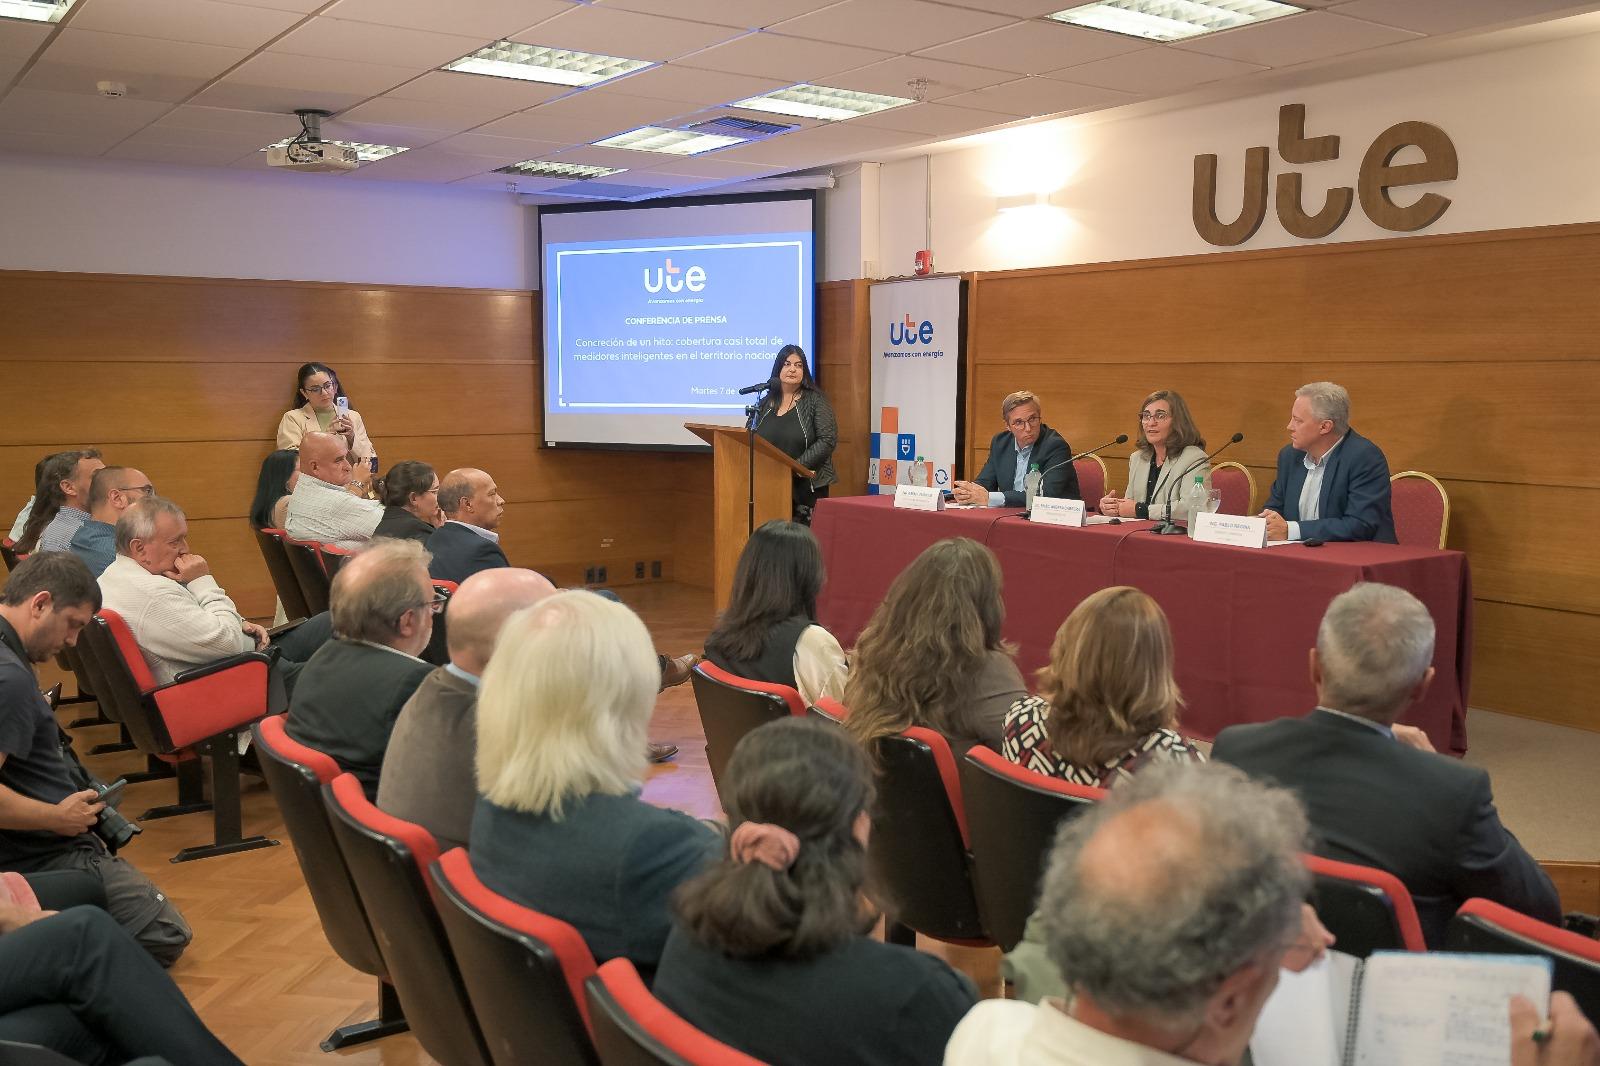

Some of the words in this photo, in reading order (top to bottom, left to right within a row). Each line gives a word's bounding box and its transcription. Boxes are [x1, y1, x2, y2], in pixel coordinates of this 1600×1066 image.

[1192, 103, 1458, 246] ute
[644, 258, 707, 293] ute
[625, 316, 680, 325] CONFERENCIA
[682, 316, 693, 324] DE
[695, 315, 727, 324] PRENSA
[890, 313, 934, 346] ute
[575, 337, 624, 347] Concreción
[626, 338, 638, 347] de
[639, 339, 651, 347] un
[653, 336, 674, 346] hito:
[675, 336, 721, 346] cobertura
[723, 336, 743, 346] casi
[745, 336, 768, 346] total
[770, 335, 783, 345] de
[573, 352, 620, 361] medidores
[621, 351, 674, 363] inteligentes
[676, 352, 688, 360] en
[689, 351, 698, 360] el
[700, 351, 743, 360] territorio
[690, 386, 718, 395] Martes
[719, 385, 725, 395] 7
[725, 386, 736, 395] de
